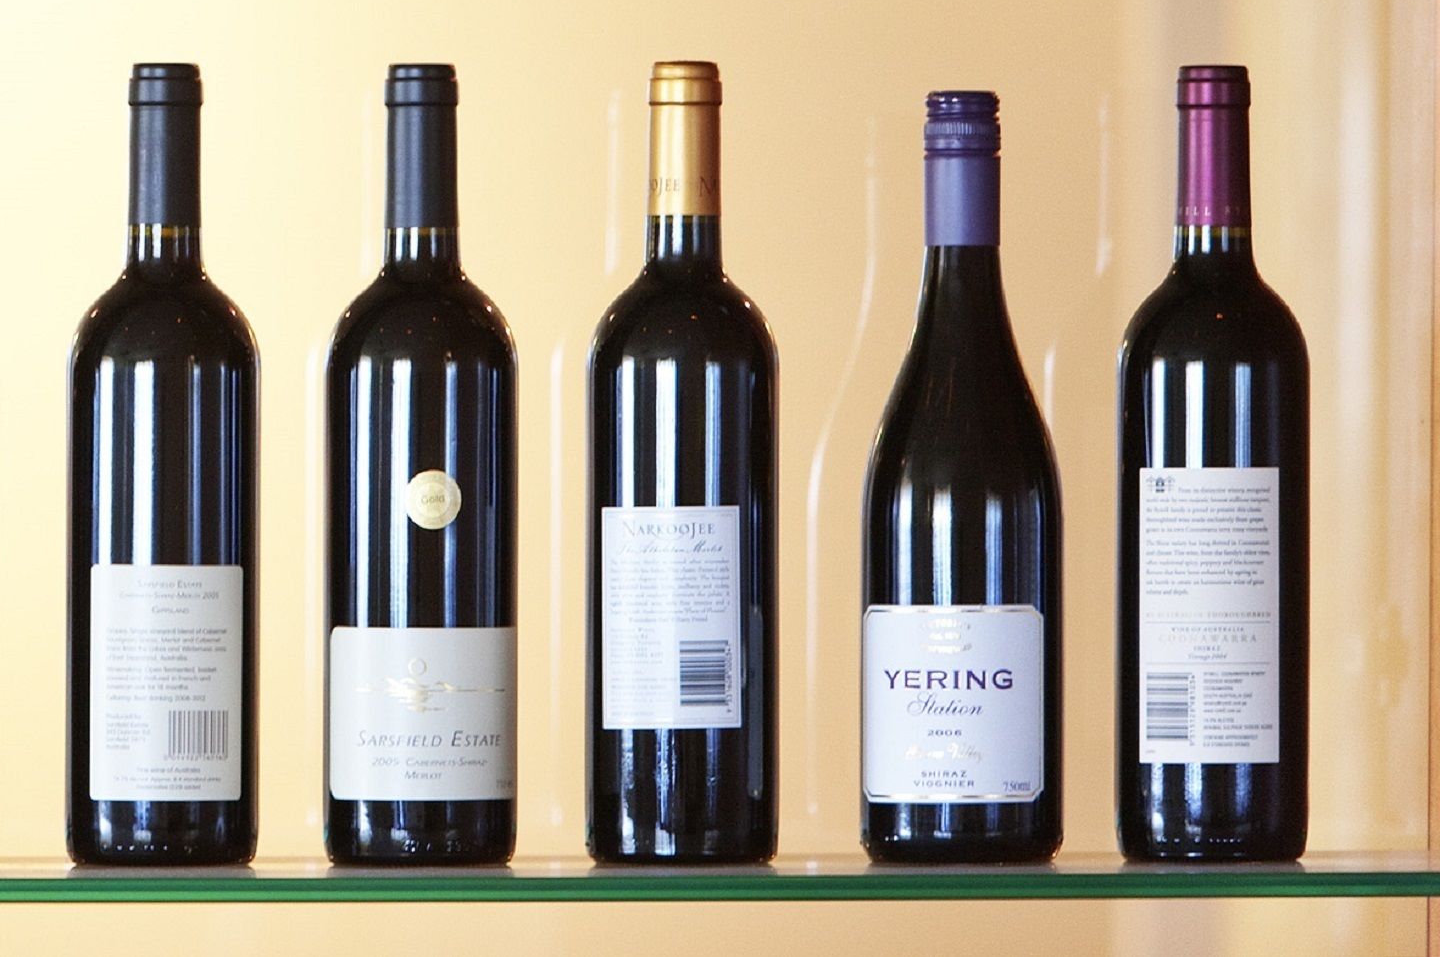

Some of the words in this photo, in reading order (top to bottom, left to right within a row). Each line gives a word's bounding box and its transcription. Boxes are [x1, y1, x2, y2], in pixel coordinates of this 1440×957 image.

[622, 520, 715, 539] NARKOOJEE
[1159, 634, 1257, 644] COONAWARRA
[884, 669, 1013, 690] YERING
[907, 692, 984, 716] Station
[359, 730, 442, 747] SARSFIELD
[451, 730, 502, 747] ESTATE
